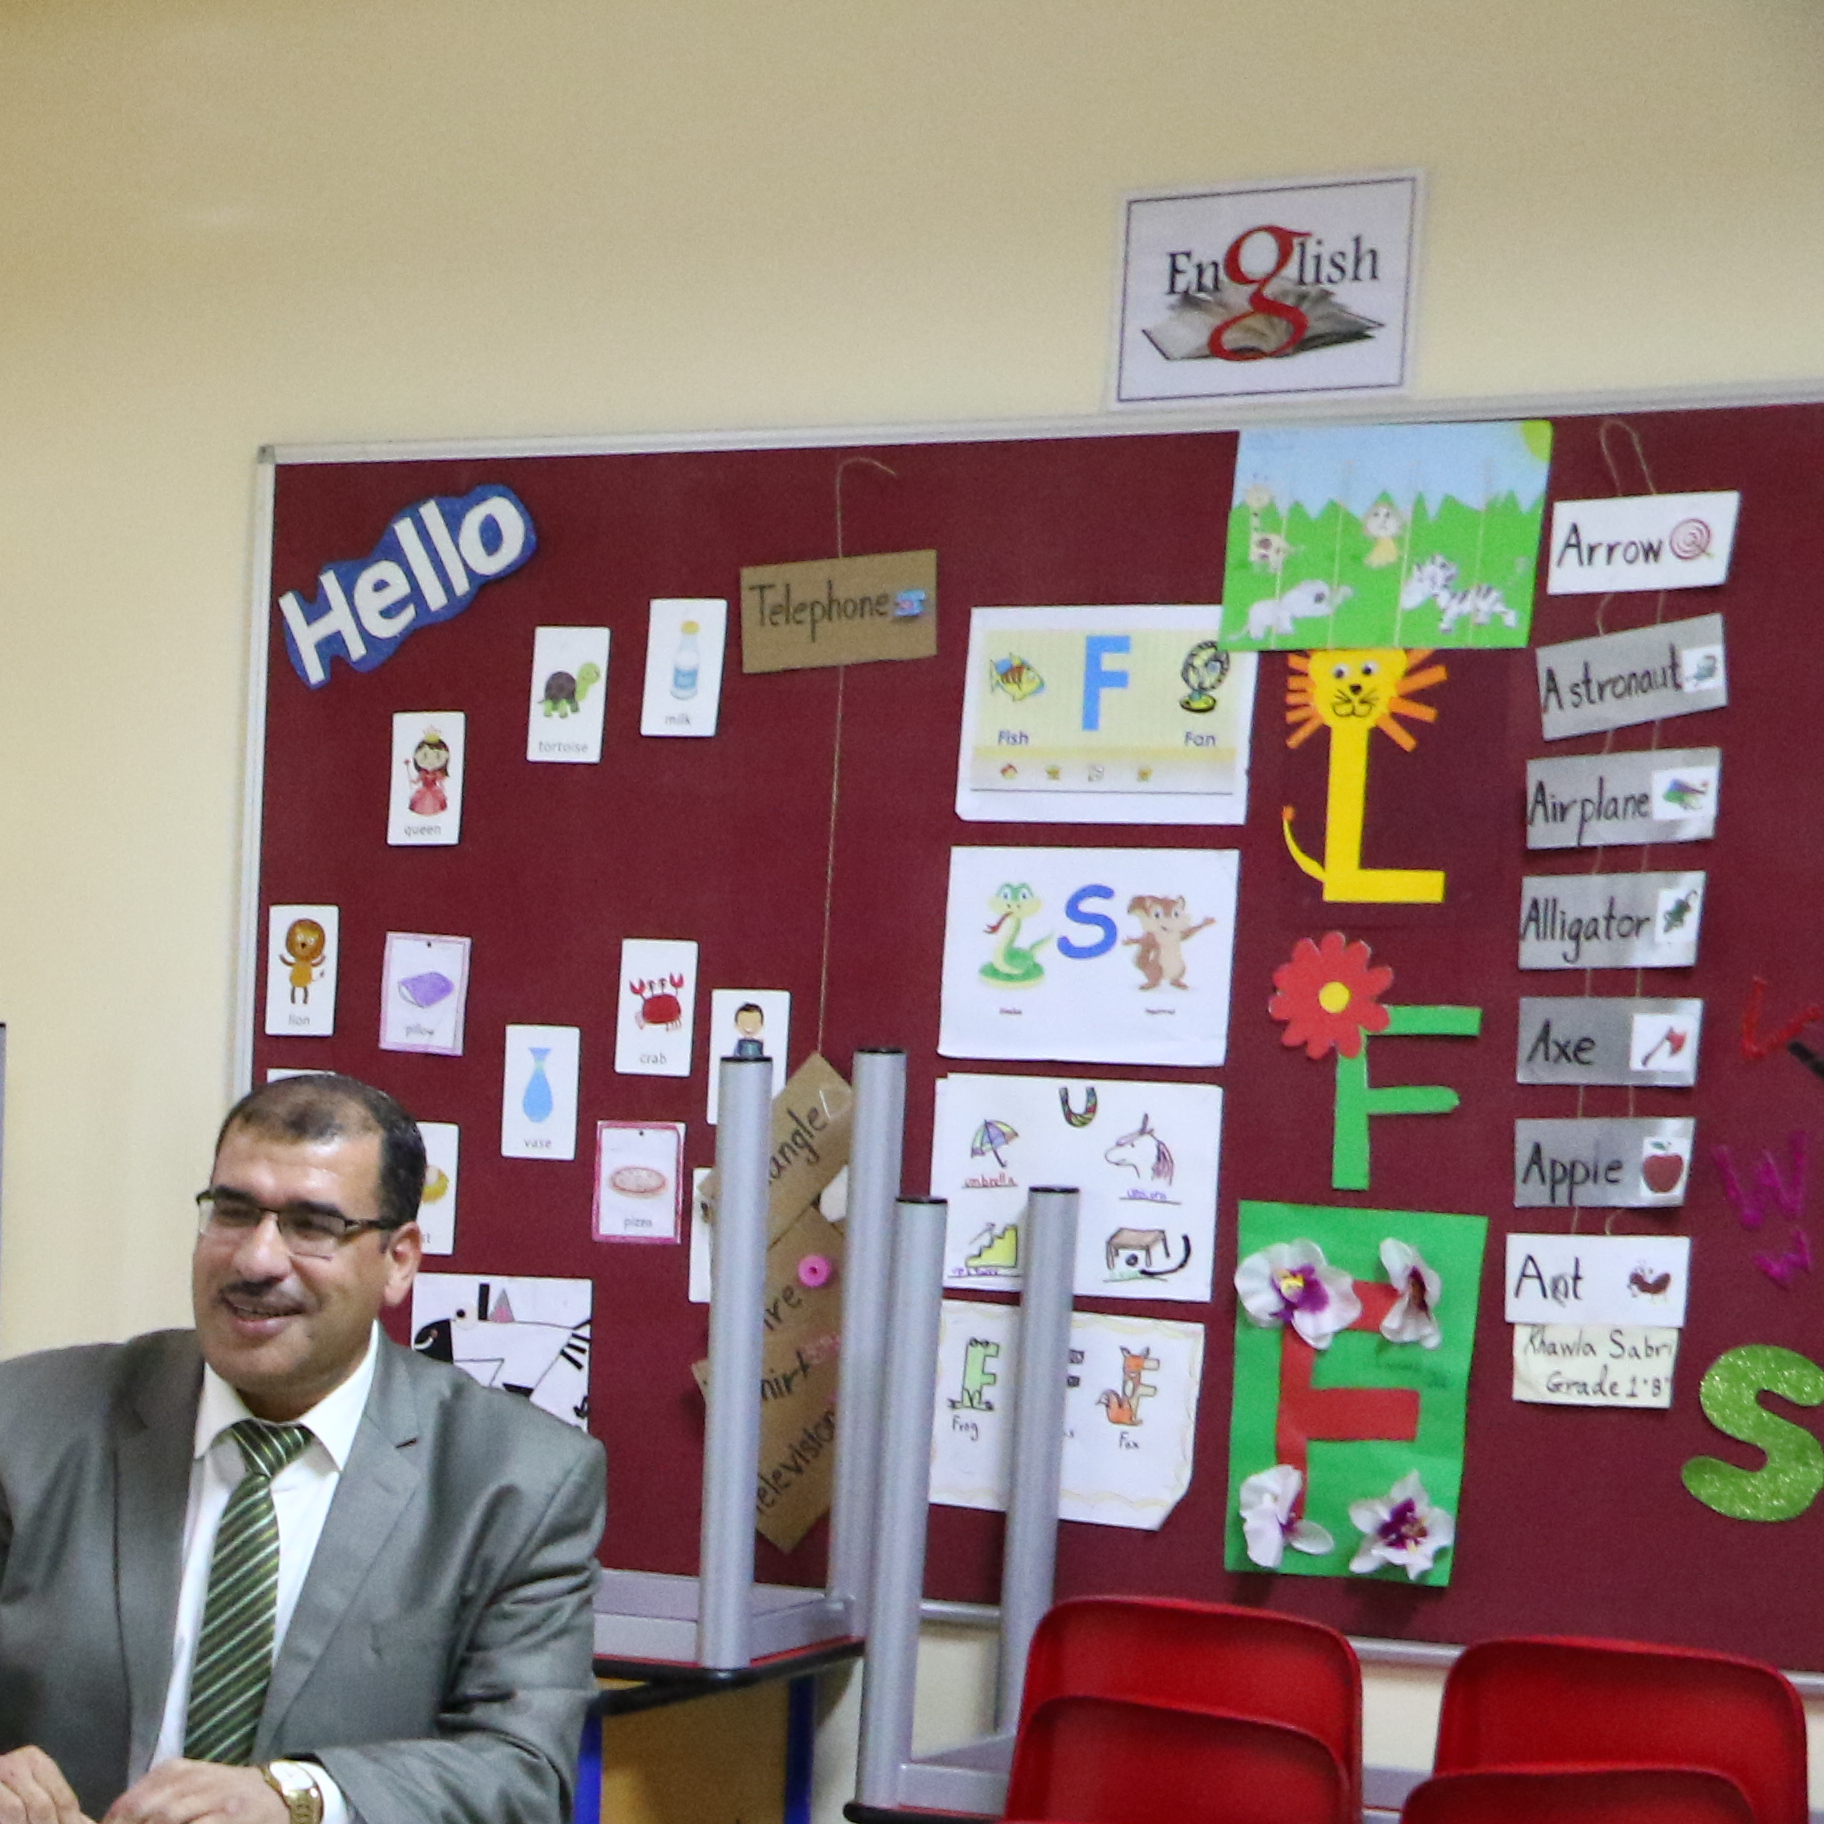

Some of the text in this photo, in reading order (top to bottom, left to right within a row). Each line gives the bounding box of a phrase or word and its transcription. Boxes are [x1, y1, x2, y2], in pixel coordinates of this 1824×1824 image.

[1166, 225, 1379, 361] English
[1557, 522, 1663, 568] Arrow
[278, 496, 525, 685] Hello
[748, 579, 890, 642] Telephone
[1082, 635, 1131, 731] F
[1543, 642, 1683, 714] Astronaut
[665, 713, 691, 726] milk
[998, 730, 1029, 745] Fish
[1184, 731, 1216, 747] Fan
[538, 740, 588, 752] tortoise
[404, 825, 442, 836] queen
[1528, 776, 1649, 847] Airplane
[1057, 884, 1118, 959] S
[1521, 896, 1650, 964] Alligator
[288, 1013, 310, 1026] lion
[639, 1053, 667, 1065] crab
[1526, 1018, 1596, 1066] Axe
[1058, 1087, 1098, 1128] U
[524, 1138, 552, 1149] vase
[1514, 1254, 1583, 1305] Ant
[1546, 1364, 1619, 1398] Grade
[952, 1415, 979, 1442] Frog
[1118, 1431, 1140, 1450] Fox
